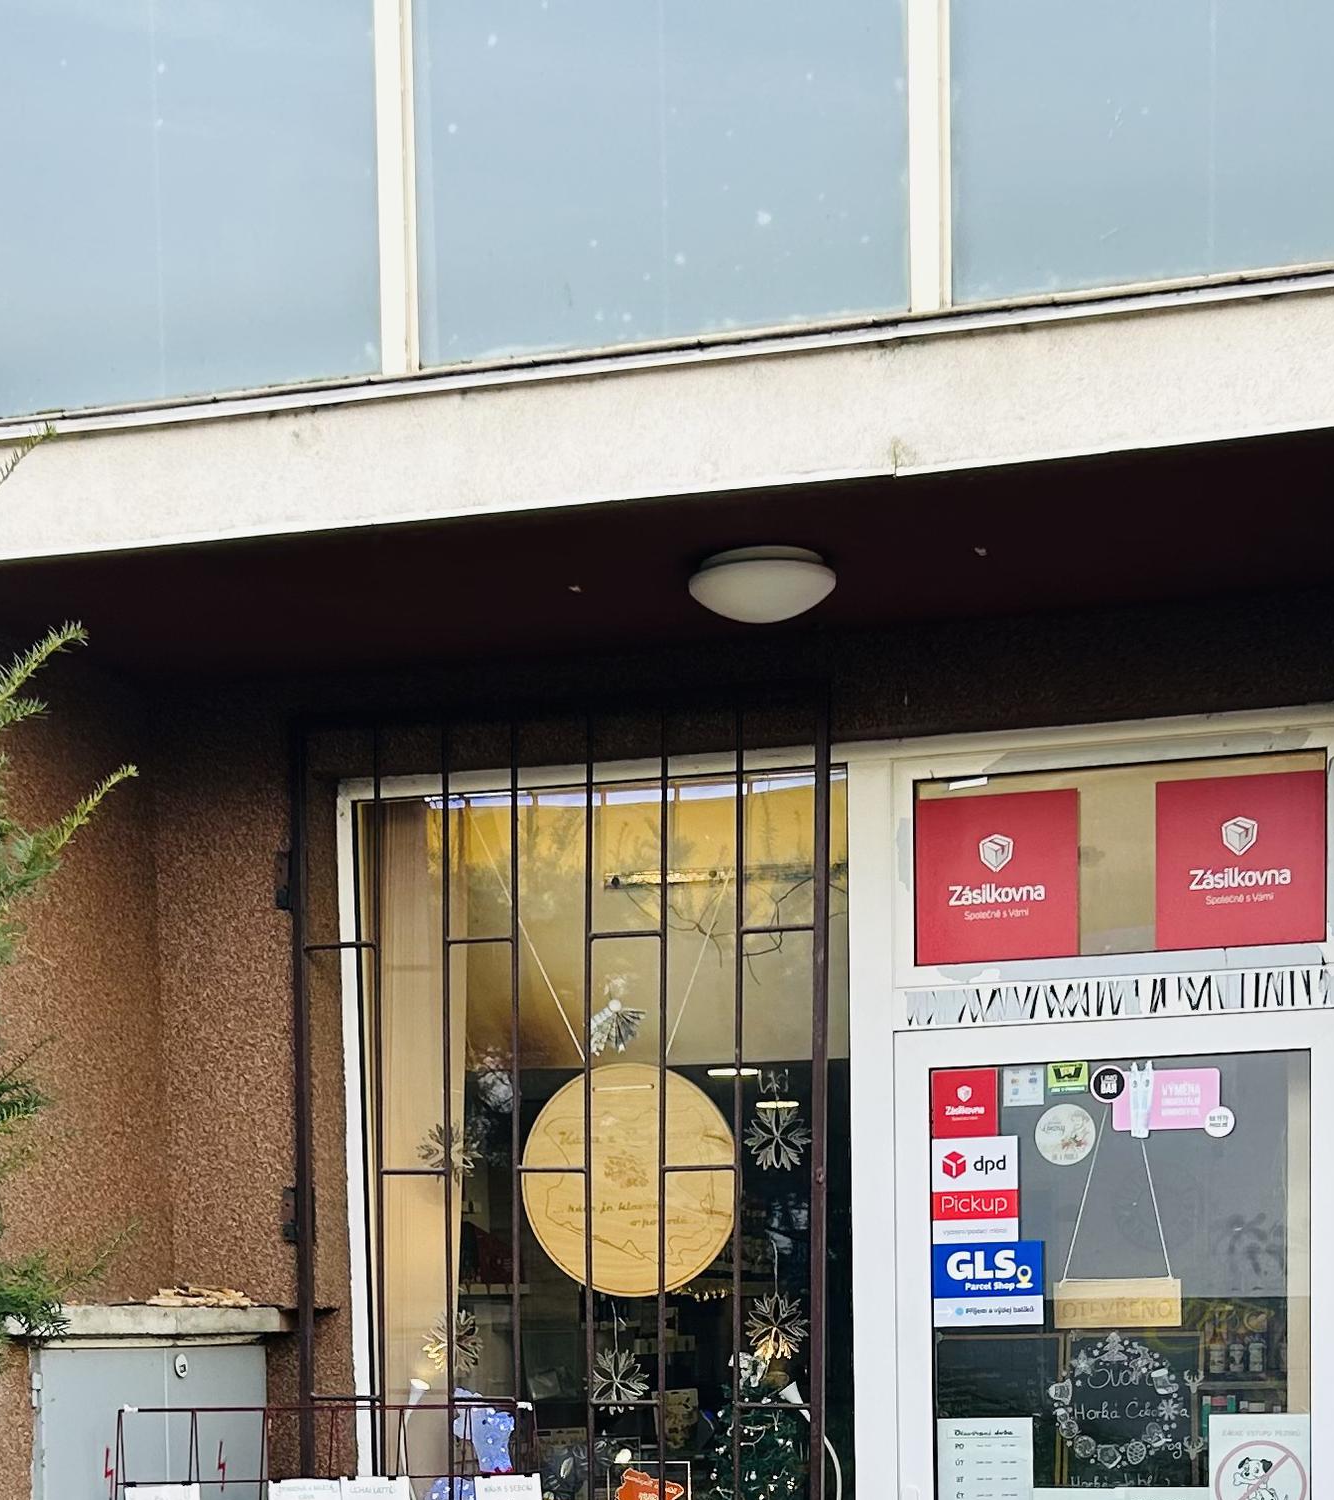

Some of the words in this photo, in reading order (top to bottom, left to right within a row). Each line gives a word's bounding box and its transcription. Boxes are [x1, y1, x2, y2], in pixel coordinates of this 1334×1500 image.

[1188, 867, 1292, 891] Zásilkovna
[948, 883, 1046, 907] Zásilkovna
[1205, 893, 1245, 906] Společně
[963, 909, 1001, 921] Společně
[973, 1155, 1007, 1175] dpd
[940, 1195, 1008, 1215] Pickup
[946, 1249, 1017, 1281] GLS
[964, 1282, 992, 1291] Parcel
[993, 1281, 1015, 1291] Shop
[1062, 1297, 1173, 1319] OTEVŘENO
